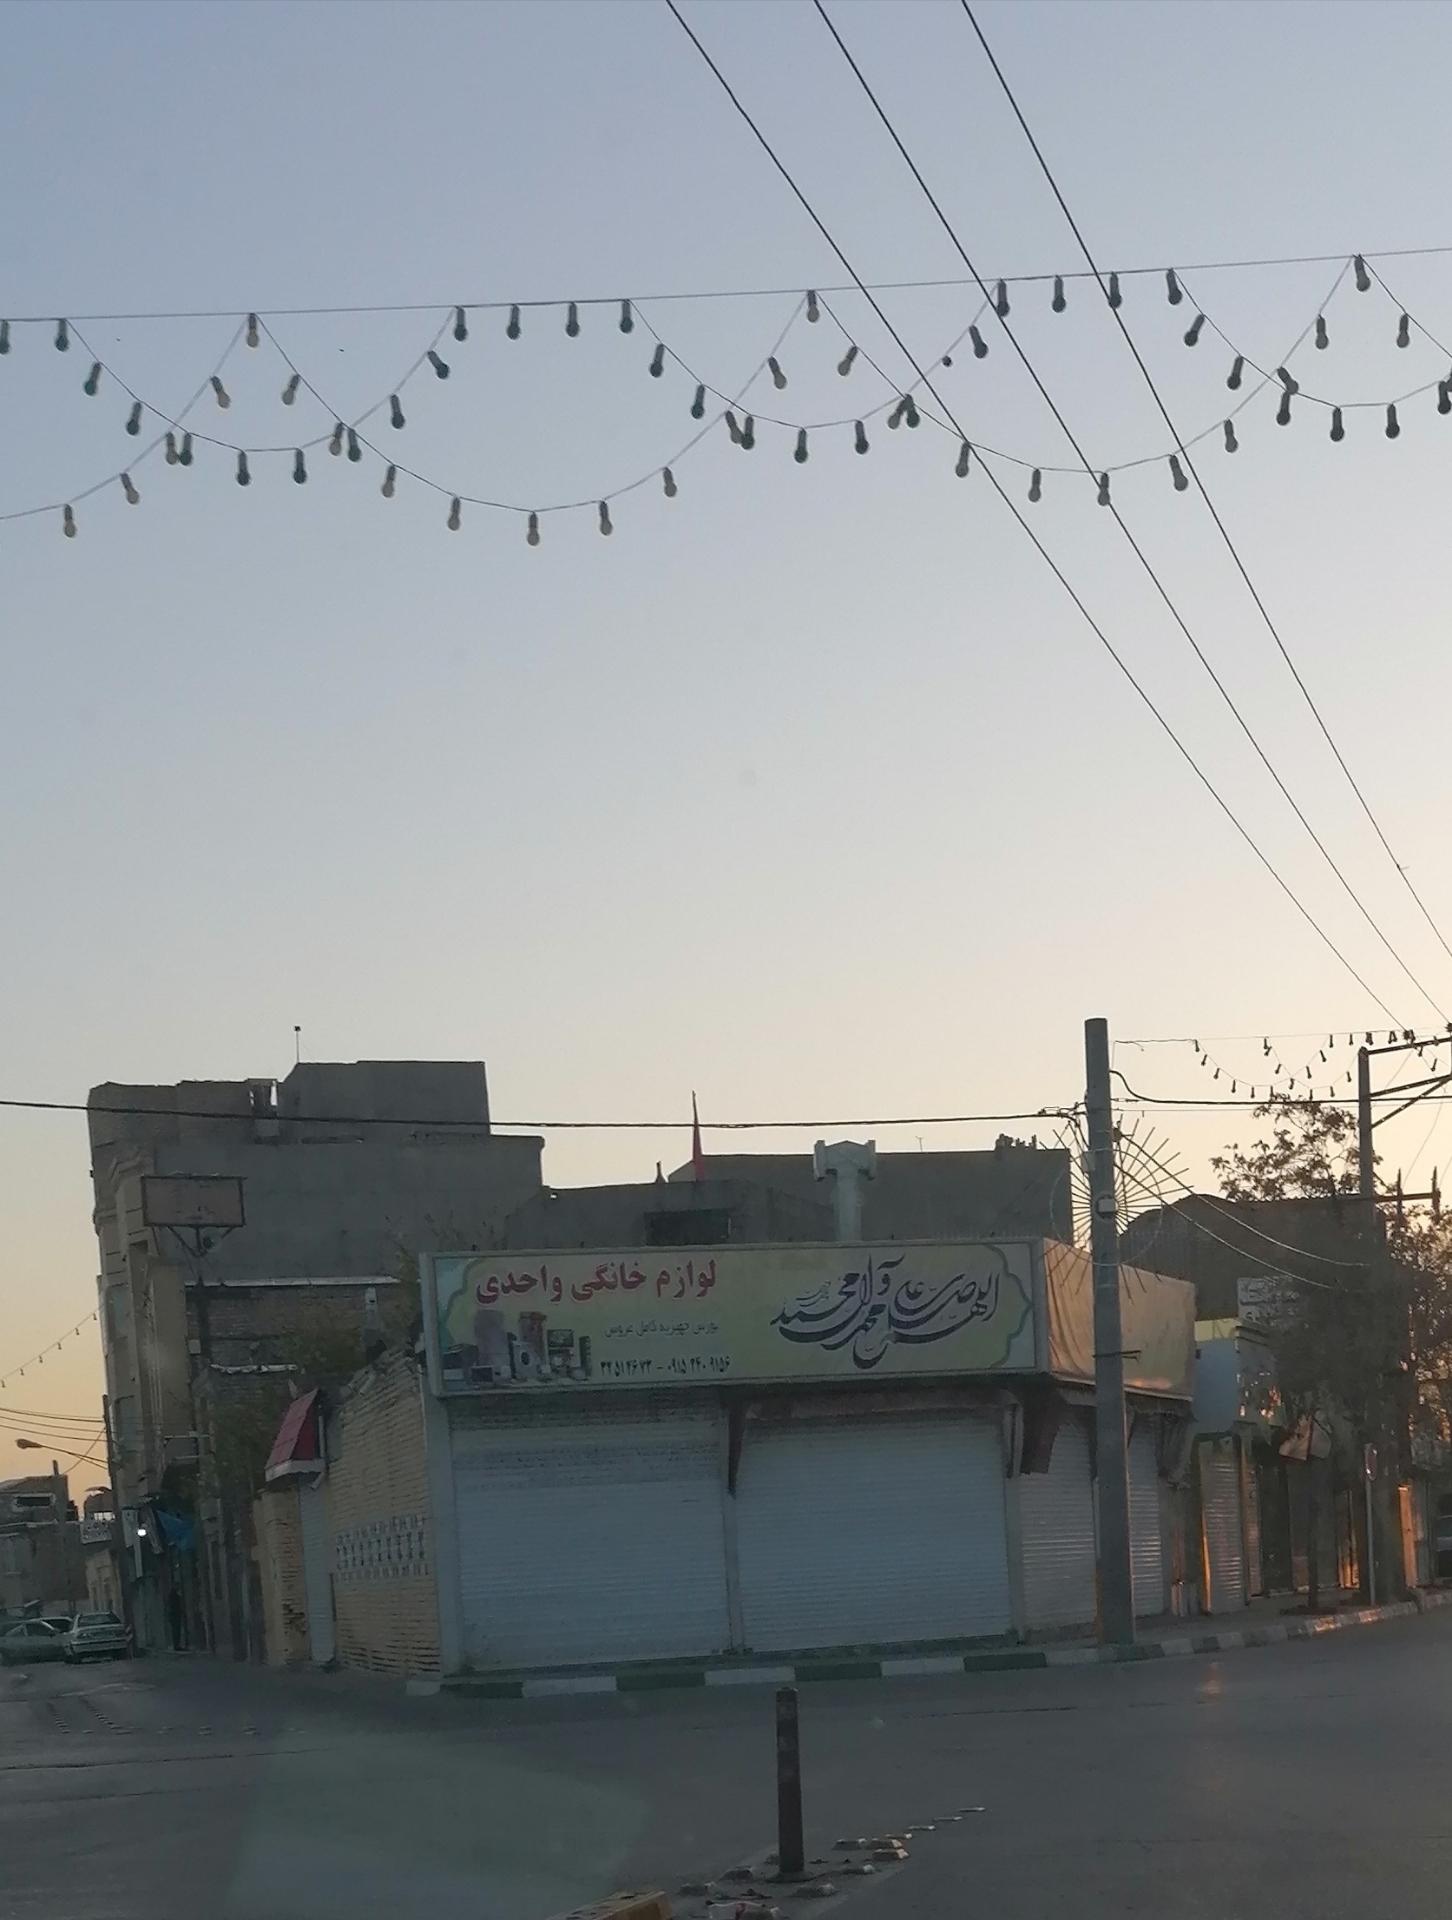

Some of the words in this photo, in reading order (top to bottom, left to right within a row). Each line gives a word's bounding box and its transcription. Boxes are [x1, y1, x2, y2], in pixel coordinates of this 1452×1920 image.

[476, 1264, 563, 1305] واحدی
[571, 1261, 647, 1301] خانگی
[655, 1259, 717, 1298] لوازم
